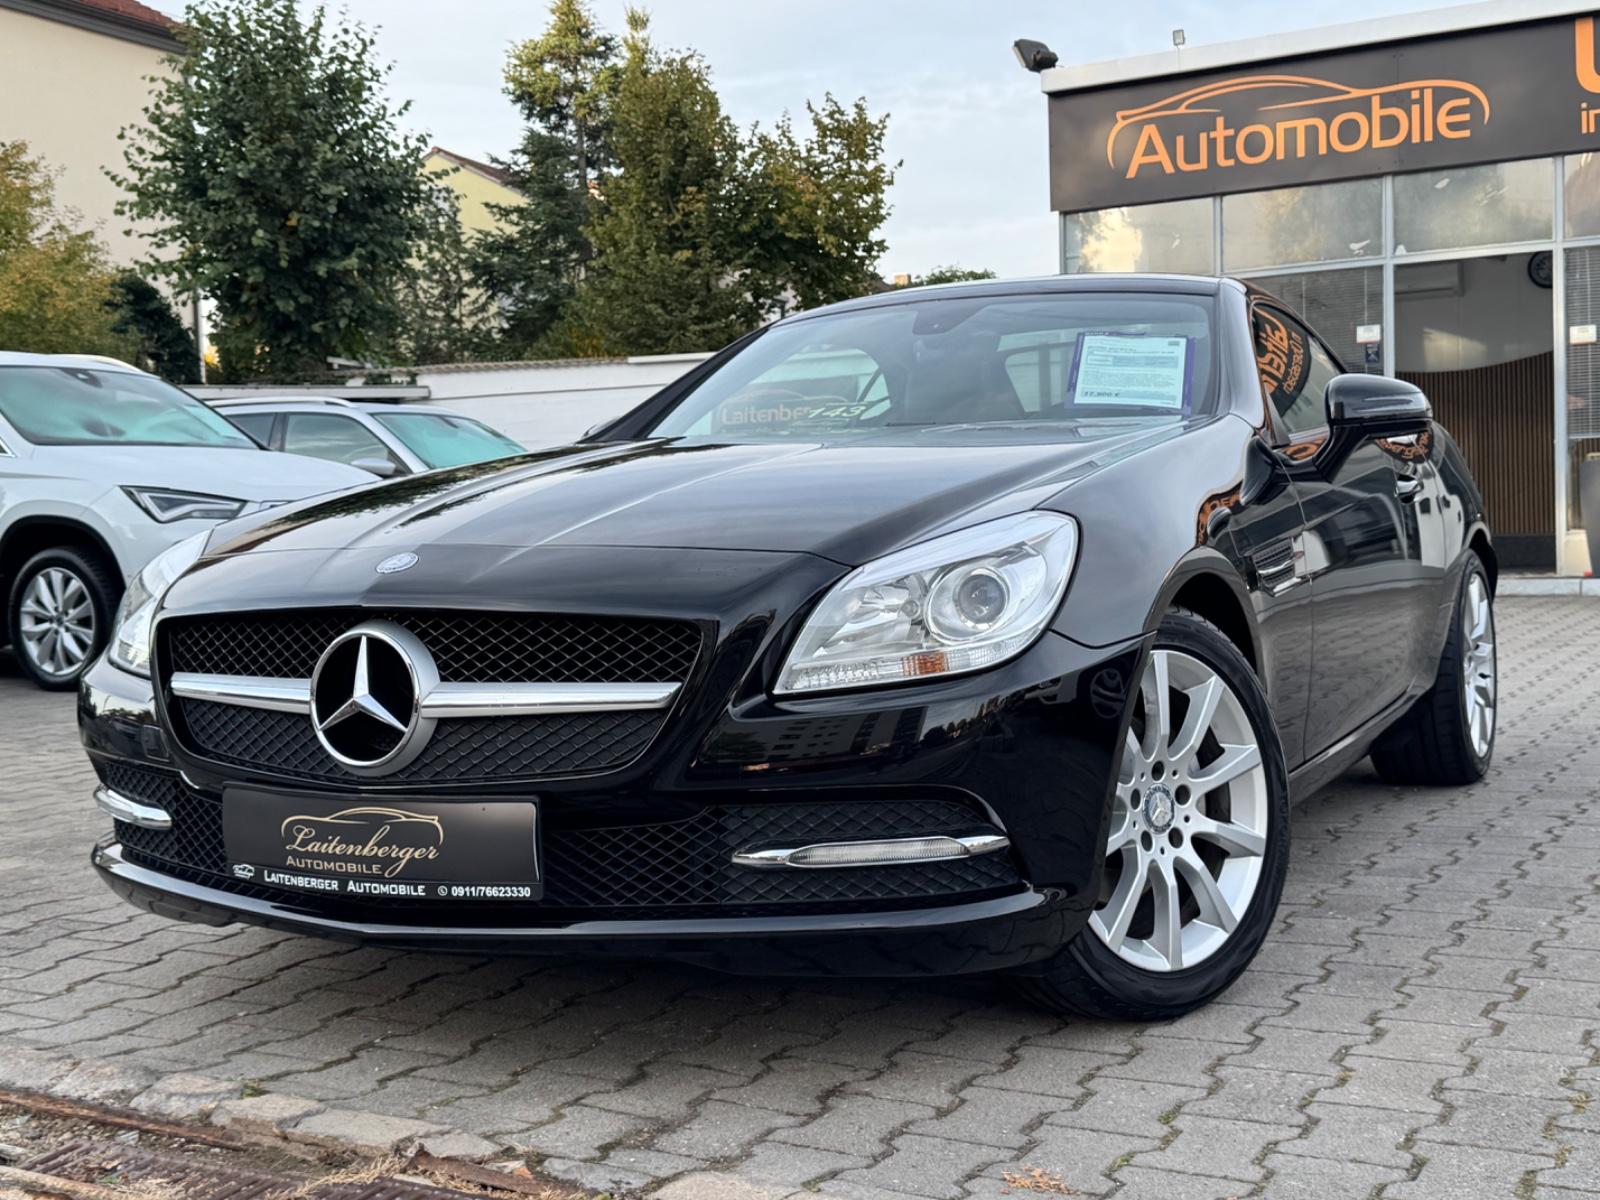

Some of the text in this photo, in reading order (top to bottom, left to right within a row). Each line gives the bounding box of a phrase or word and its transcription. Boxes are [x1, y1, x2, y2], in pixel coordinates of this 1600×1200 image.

[1126, 88, 1471, 179] Automobile
[286, 825, 440, 878] Laitenberger
[451, 886, 531, 897] 0911/76623330
